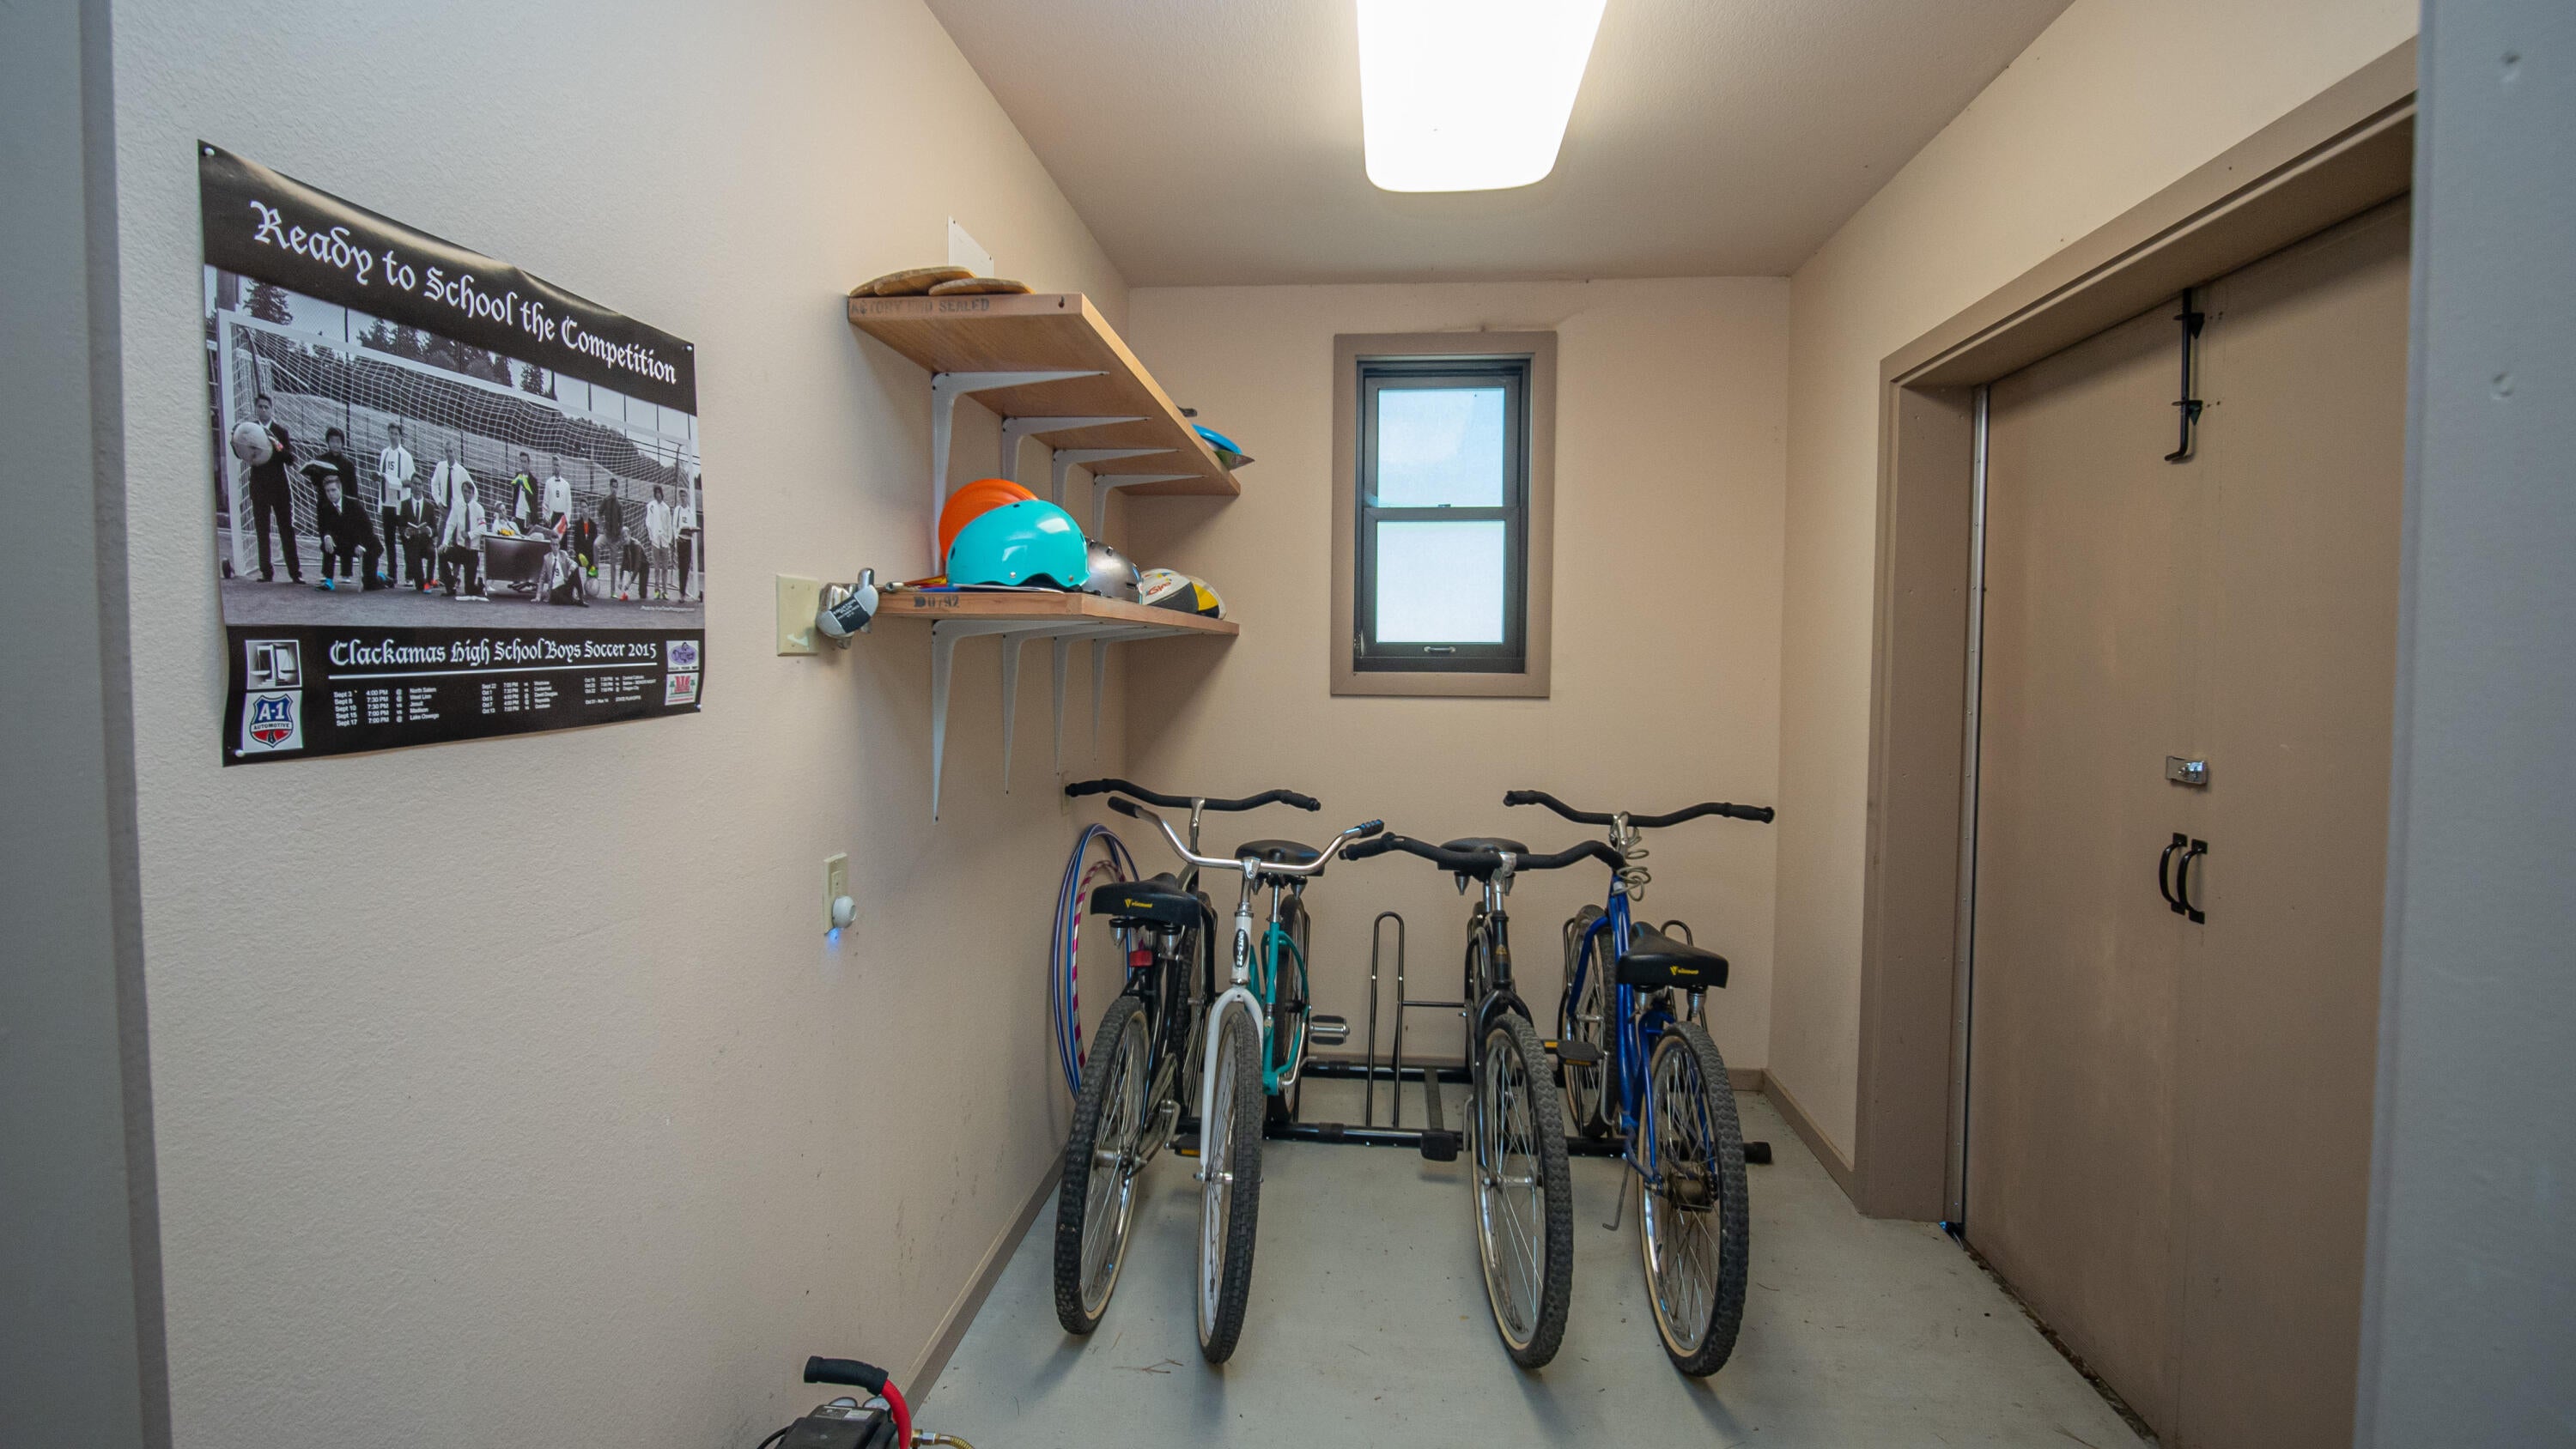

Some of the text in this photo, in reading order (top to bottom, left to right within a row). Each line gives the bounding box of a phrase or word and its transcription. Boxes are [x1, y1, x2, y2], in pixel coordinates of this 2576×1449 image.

[250, 200, 677, 385] Ready to School the Competition
[939, 298, 990, 312] SEALED
[330, 639, 446, 666] Clackamas
[450, 638, 489, 666] High
[494, 638, 544, 664] School
[544, 640, 581, 663] Boys
[584, 640, 625, 658] Soccer
[628, 643, 657, 658] 2015
[258, 702, 285, 722] A-1
[253, 723, 290, 731] AUTOMOTIVE
